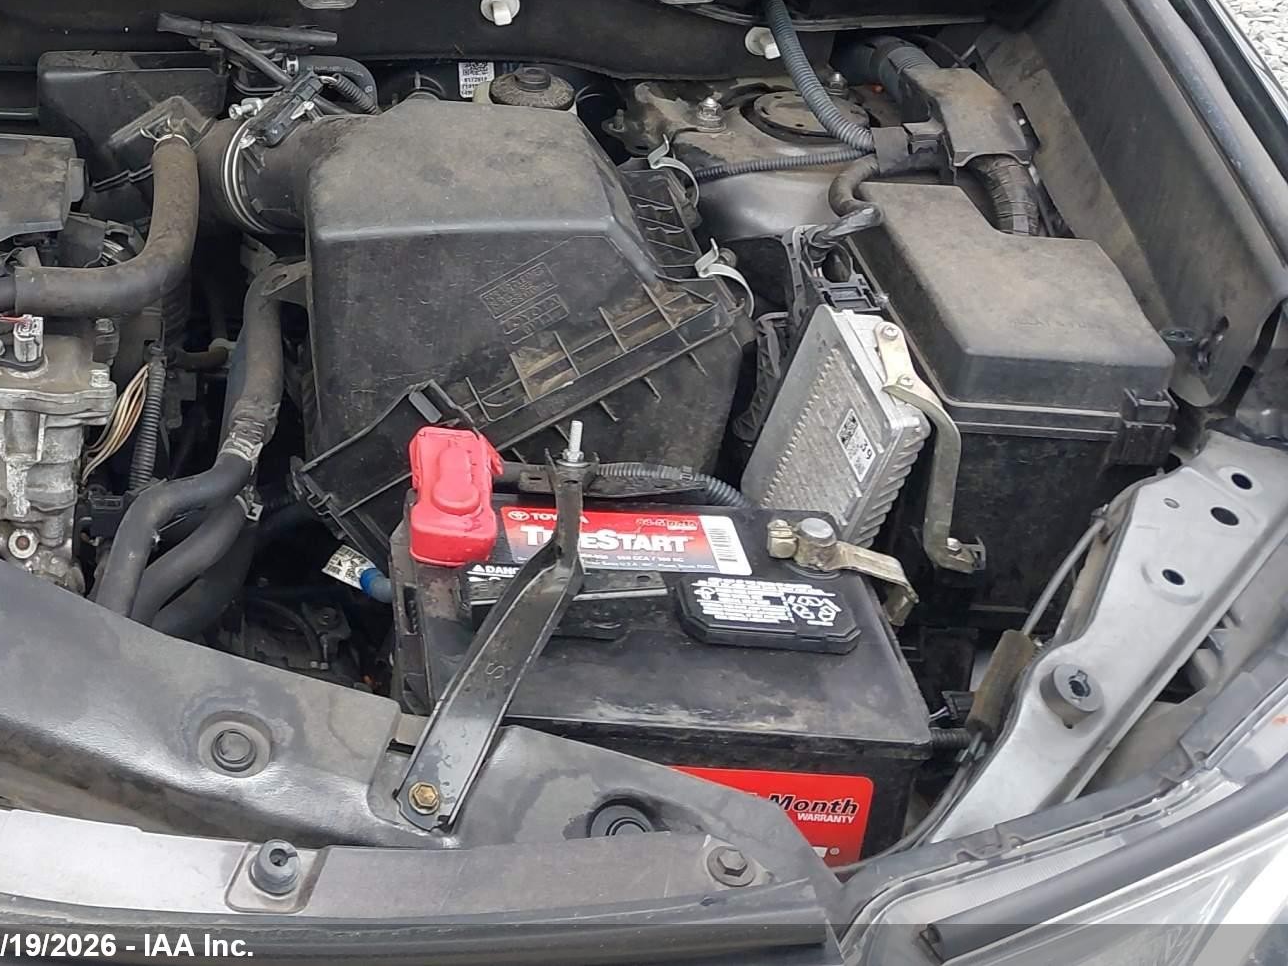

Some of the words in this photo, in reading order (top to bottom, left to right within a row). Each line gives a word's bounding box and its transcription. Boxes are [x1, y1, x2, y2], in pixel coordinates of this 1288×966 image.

[530, 513, 589, 524] TOYA
[768, 793, 859, 814] Month
[797, 812, 855, 824] WARRANTY
